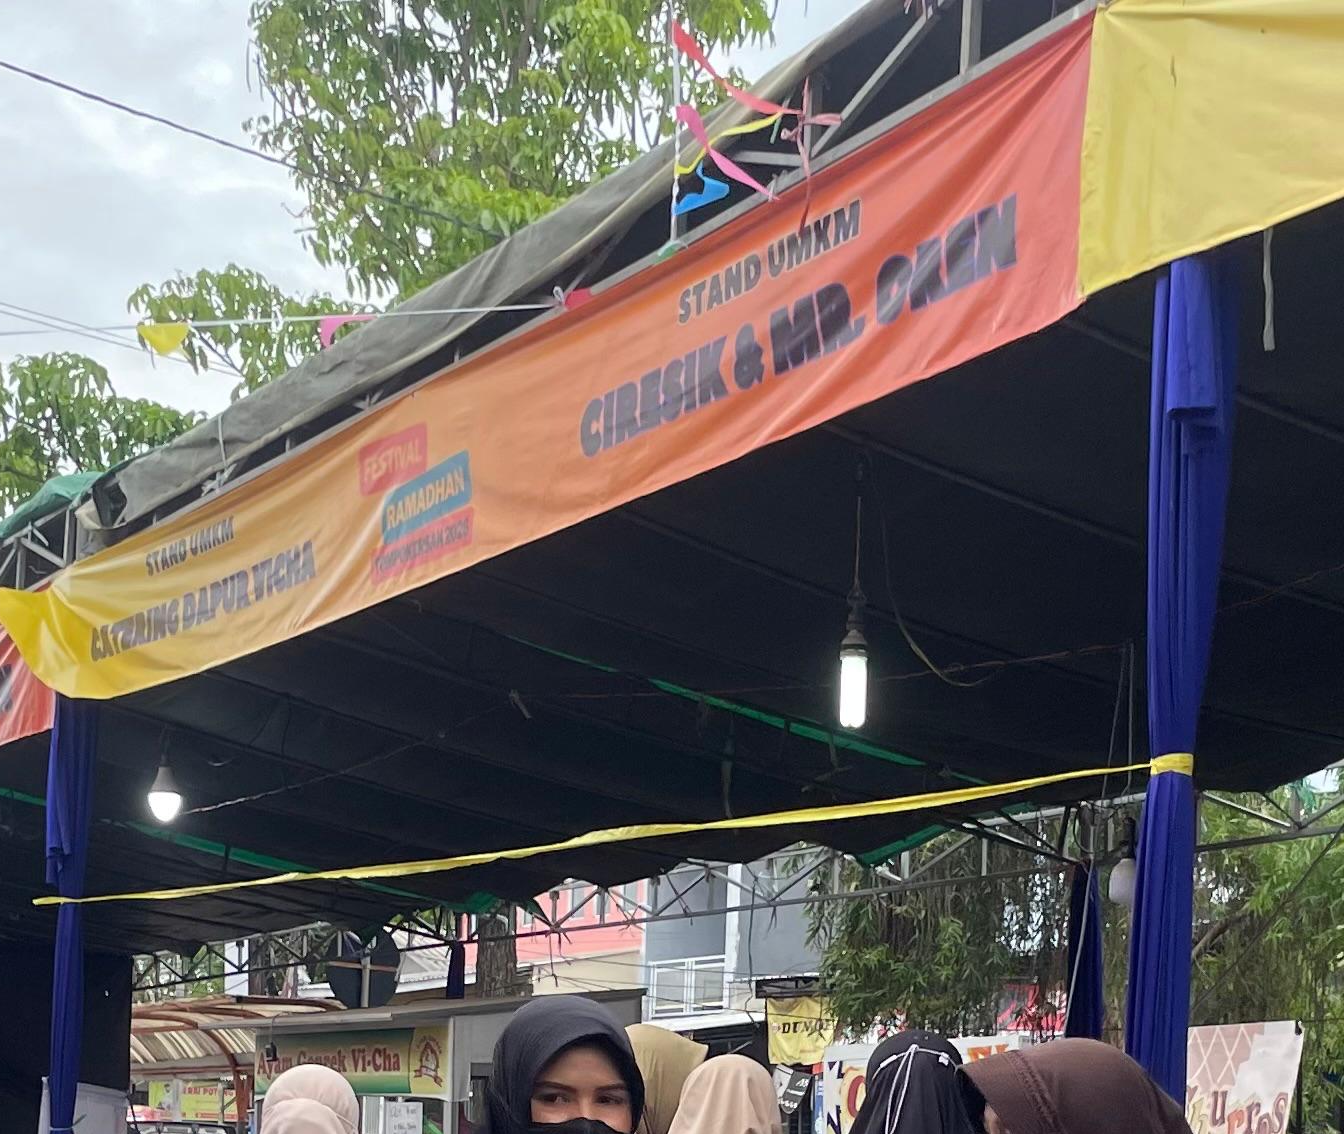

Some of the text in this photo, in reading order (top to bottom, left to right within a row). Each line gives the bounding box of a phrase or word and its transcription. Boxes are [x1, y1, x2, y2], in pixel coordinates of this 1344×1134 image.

[678, 200, 861, 323] STAND UMKM
[580, 335, 728, 458] CIRESIK
[734, 323, 764, 389] &
[364, 439, 422, 483] FESTIVAL
[386, 466, 464, 530] RAMADHAN
[146, 516, 234, 576] STAND UMKM
[182, 570, 251, 629] DAPUR
[351, 1048, 400, 1072] Vi-Cha
